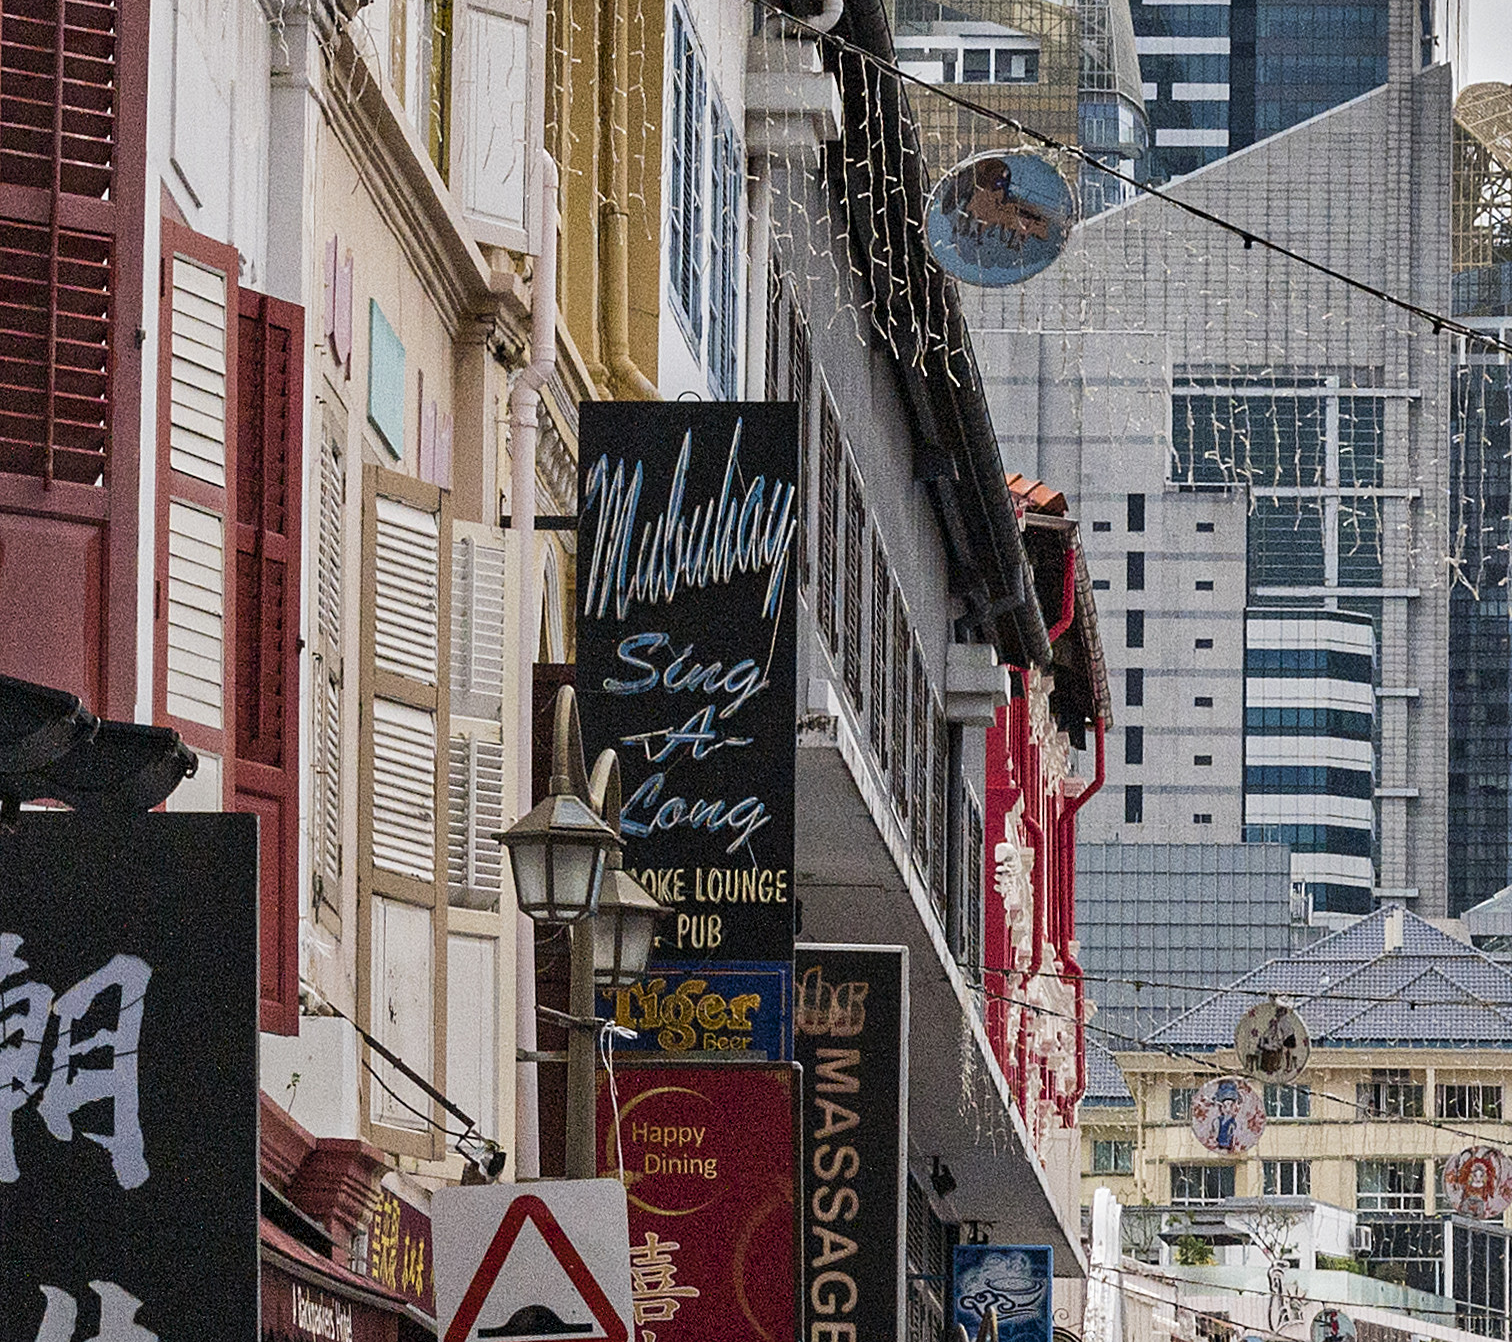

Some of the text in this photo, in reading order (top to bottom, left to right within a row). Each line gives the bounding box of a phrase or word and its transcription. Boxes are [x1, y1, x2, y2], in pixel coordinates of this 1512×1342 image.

[602, 631, 770, 718] Sing
[619, 772, 771, 853] Long
[695, 868, 786, 903] LOUNGE
[678, 914, 722, 947] PUB
[602, 979, 762, 1052] Tiger
[704, 1033, 752, 1050] Beer
[632, 1122, 706, 1151] Happy
[645, 1153, 718, 1180] Dining
